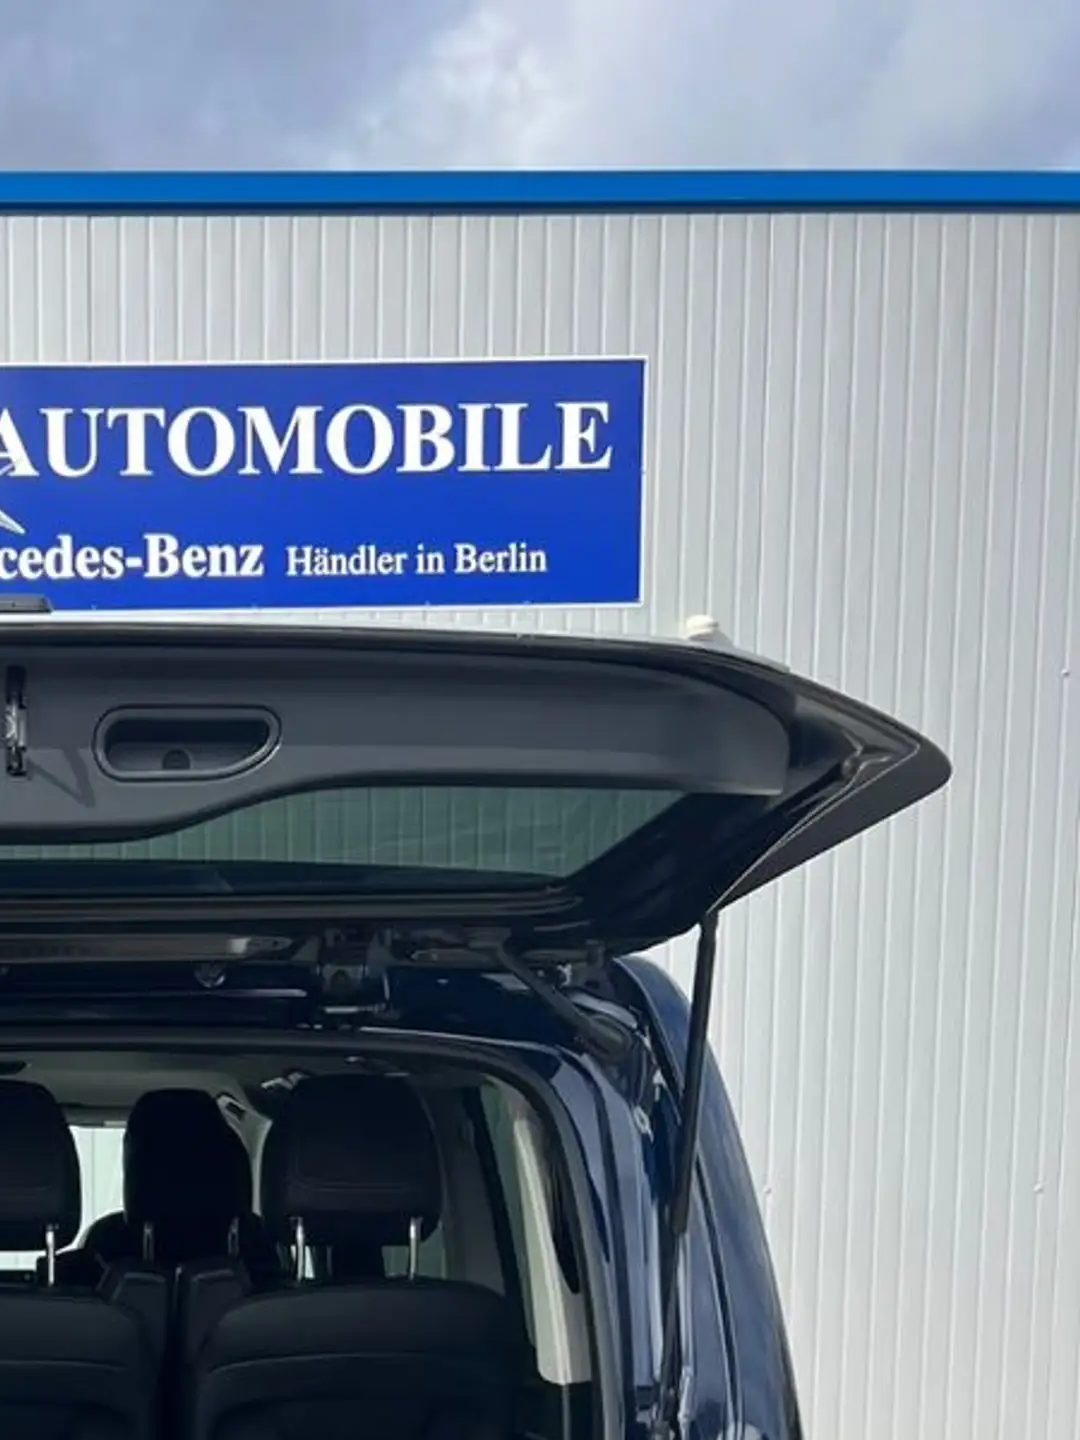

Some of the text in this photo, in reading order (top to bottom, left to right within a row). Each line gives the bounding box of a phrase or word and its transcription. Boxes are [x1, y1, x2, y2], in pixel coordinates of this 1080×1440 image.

[286, 544, 407, 576] Händler
[417, 543, 445, 575] in
[454, 542, 548, 574] Berlin
